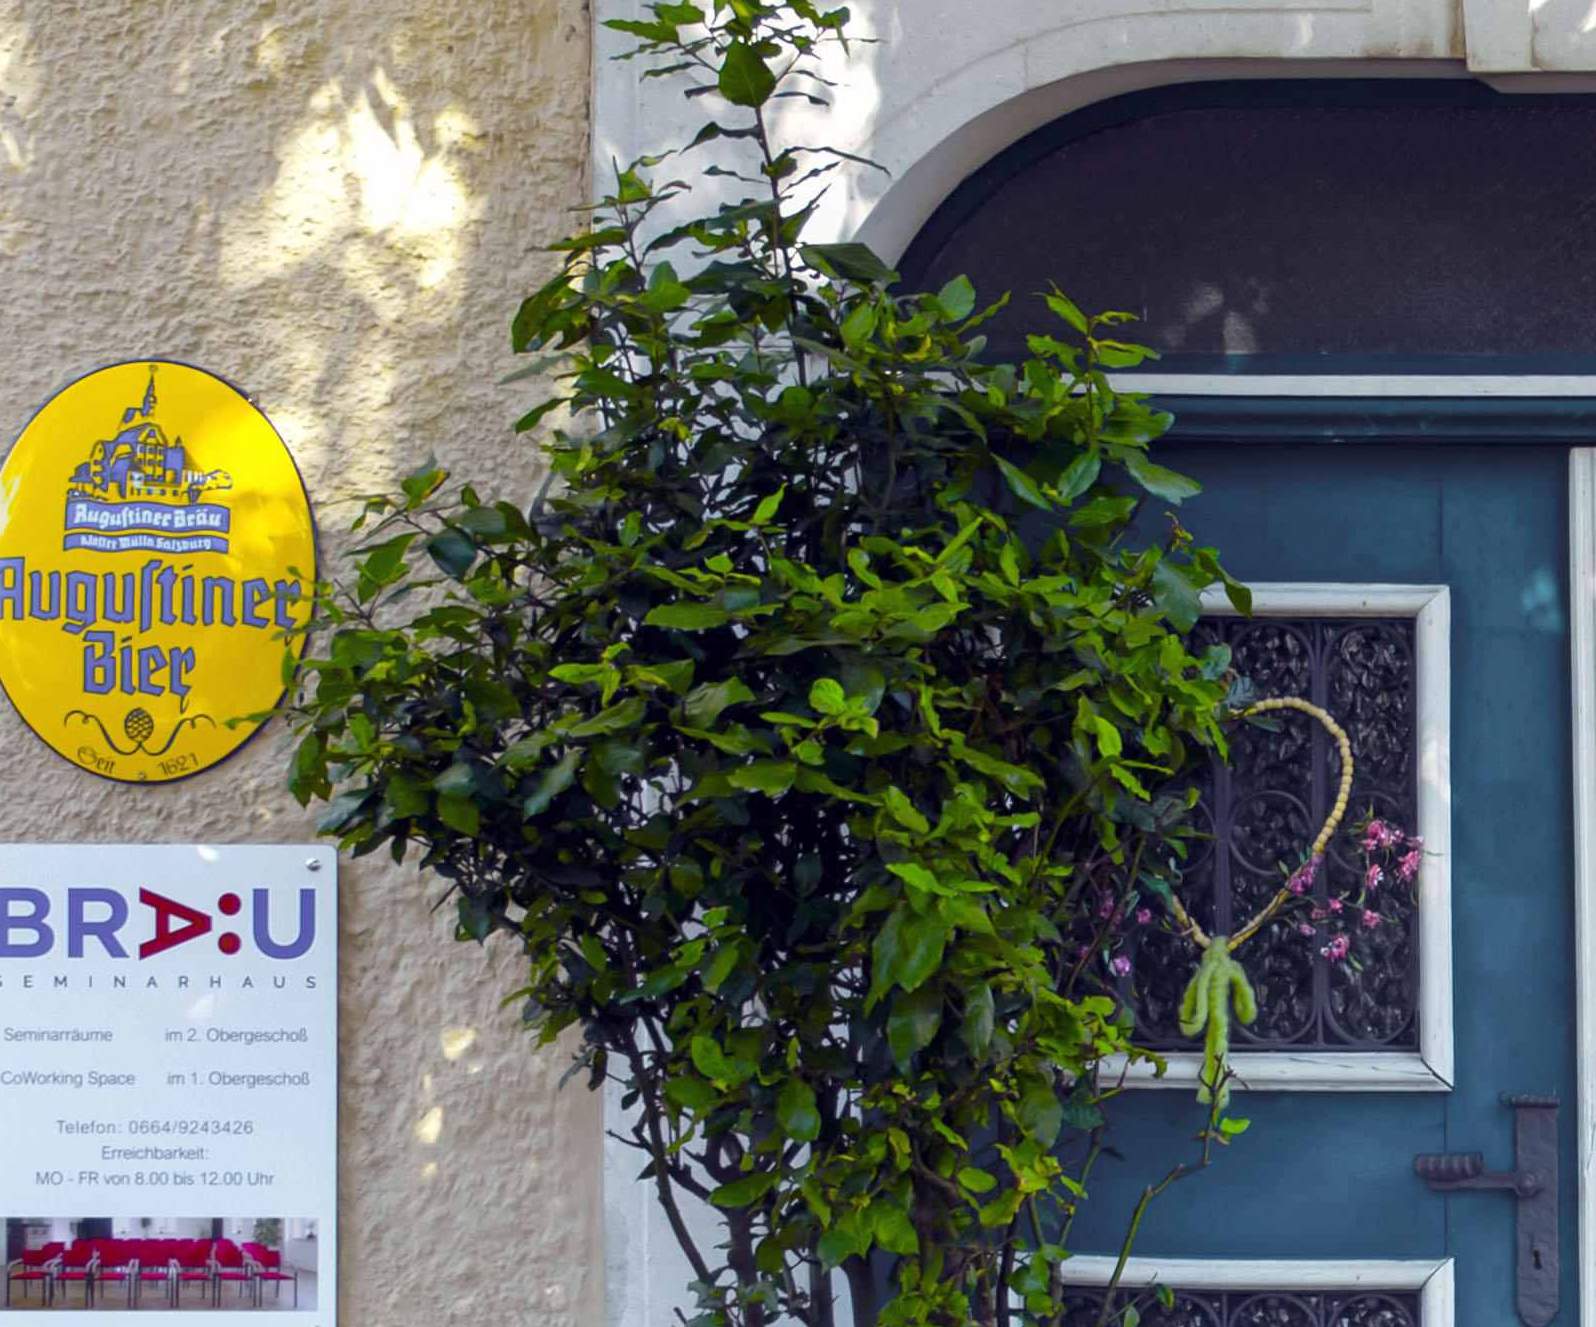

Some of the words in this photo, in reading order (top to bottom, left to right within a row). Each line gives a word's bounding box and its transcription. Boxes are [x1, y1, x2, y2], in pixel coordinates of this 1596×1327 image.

[173, 508, 222, 528] Bräu
[82, 630, 196, 713] Bier
[77, 745, 116, 774] Seit
[158, 751, 199, 776] 1621
[3, 1028, 113, 1042] Seminarräume
[165, 1028, 183, 1041] im
[187, 1028, 201, 1042] 2.
[206, 1027, 309, 1044] Obergeschoß
[0, 1071, 83, 1088] CoWorking
[87, 1071, 136, 1087] Space
[167, 1072, 185, 1085] im
[191, 1072, 203, 1086] 1.
[208, 1071, 310, 1088] Obergeschoß
[56, 1120, 122, 1134] Telefon:
[128, 1120, 254, 1135] 0664/9243426
[102, 1146, 209, 1160] Erreichbarkeit:
[35, 1172, 64, 1186] MO
[78, 1172, 99, 1186] FR
[104, 1175, 131, 1186] von
[135, 1172, 169, 1186] 8.00
[173, 1172, 195, 1186] bis
[200, 1172, 242, 1186] 12.00
[247, 1172, 276, 1186] Uhr
